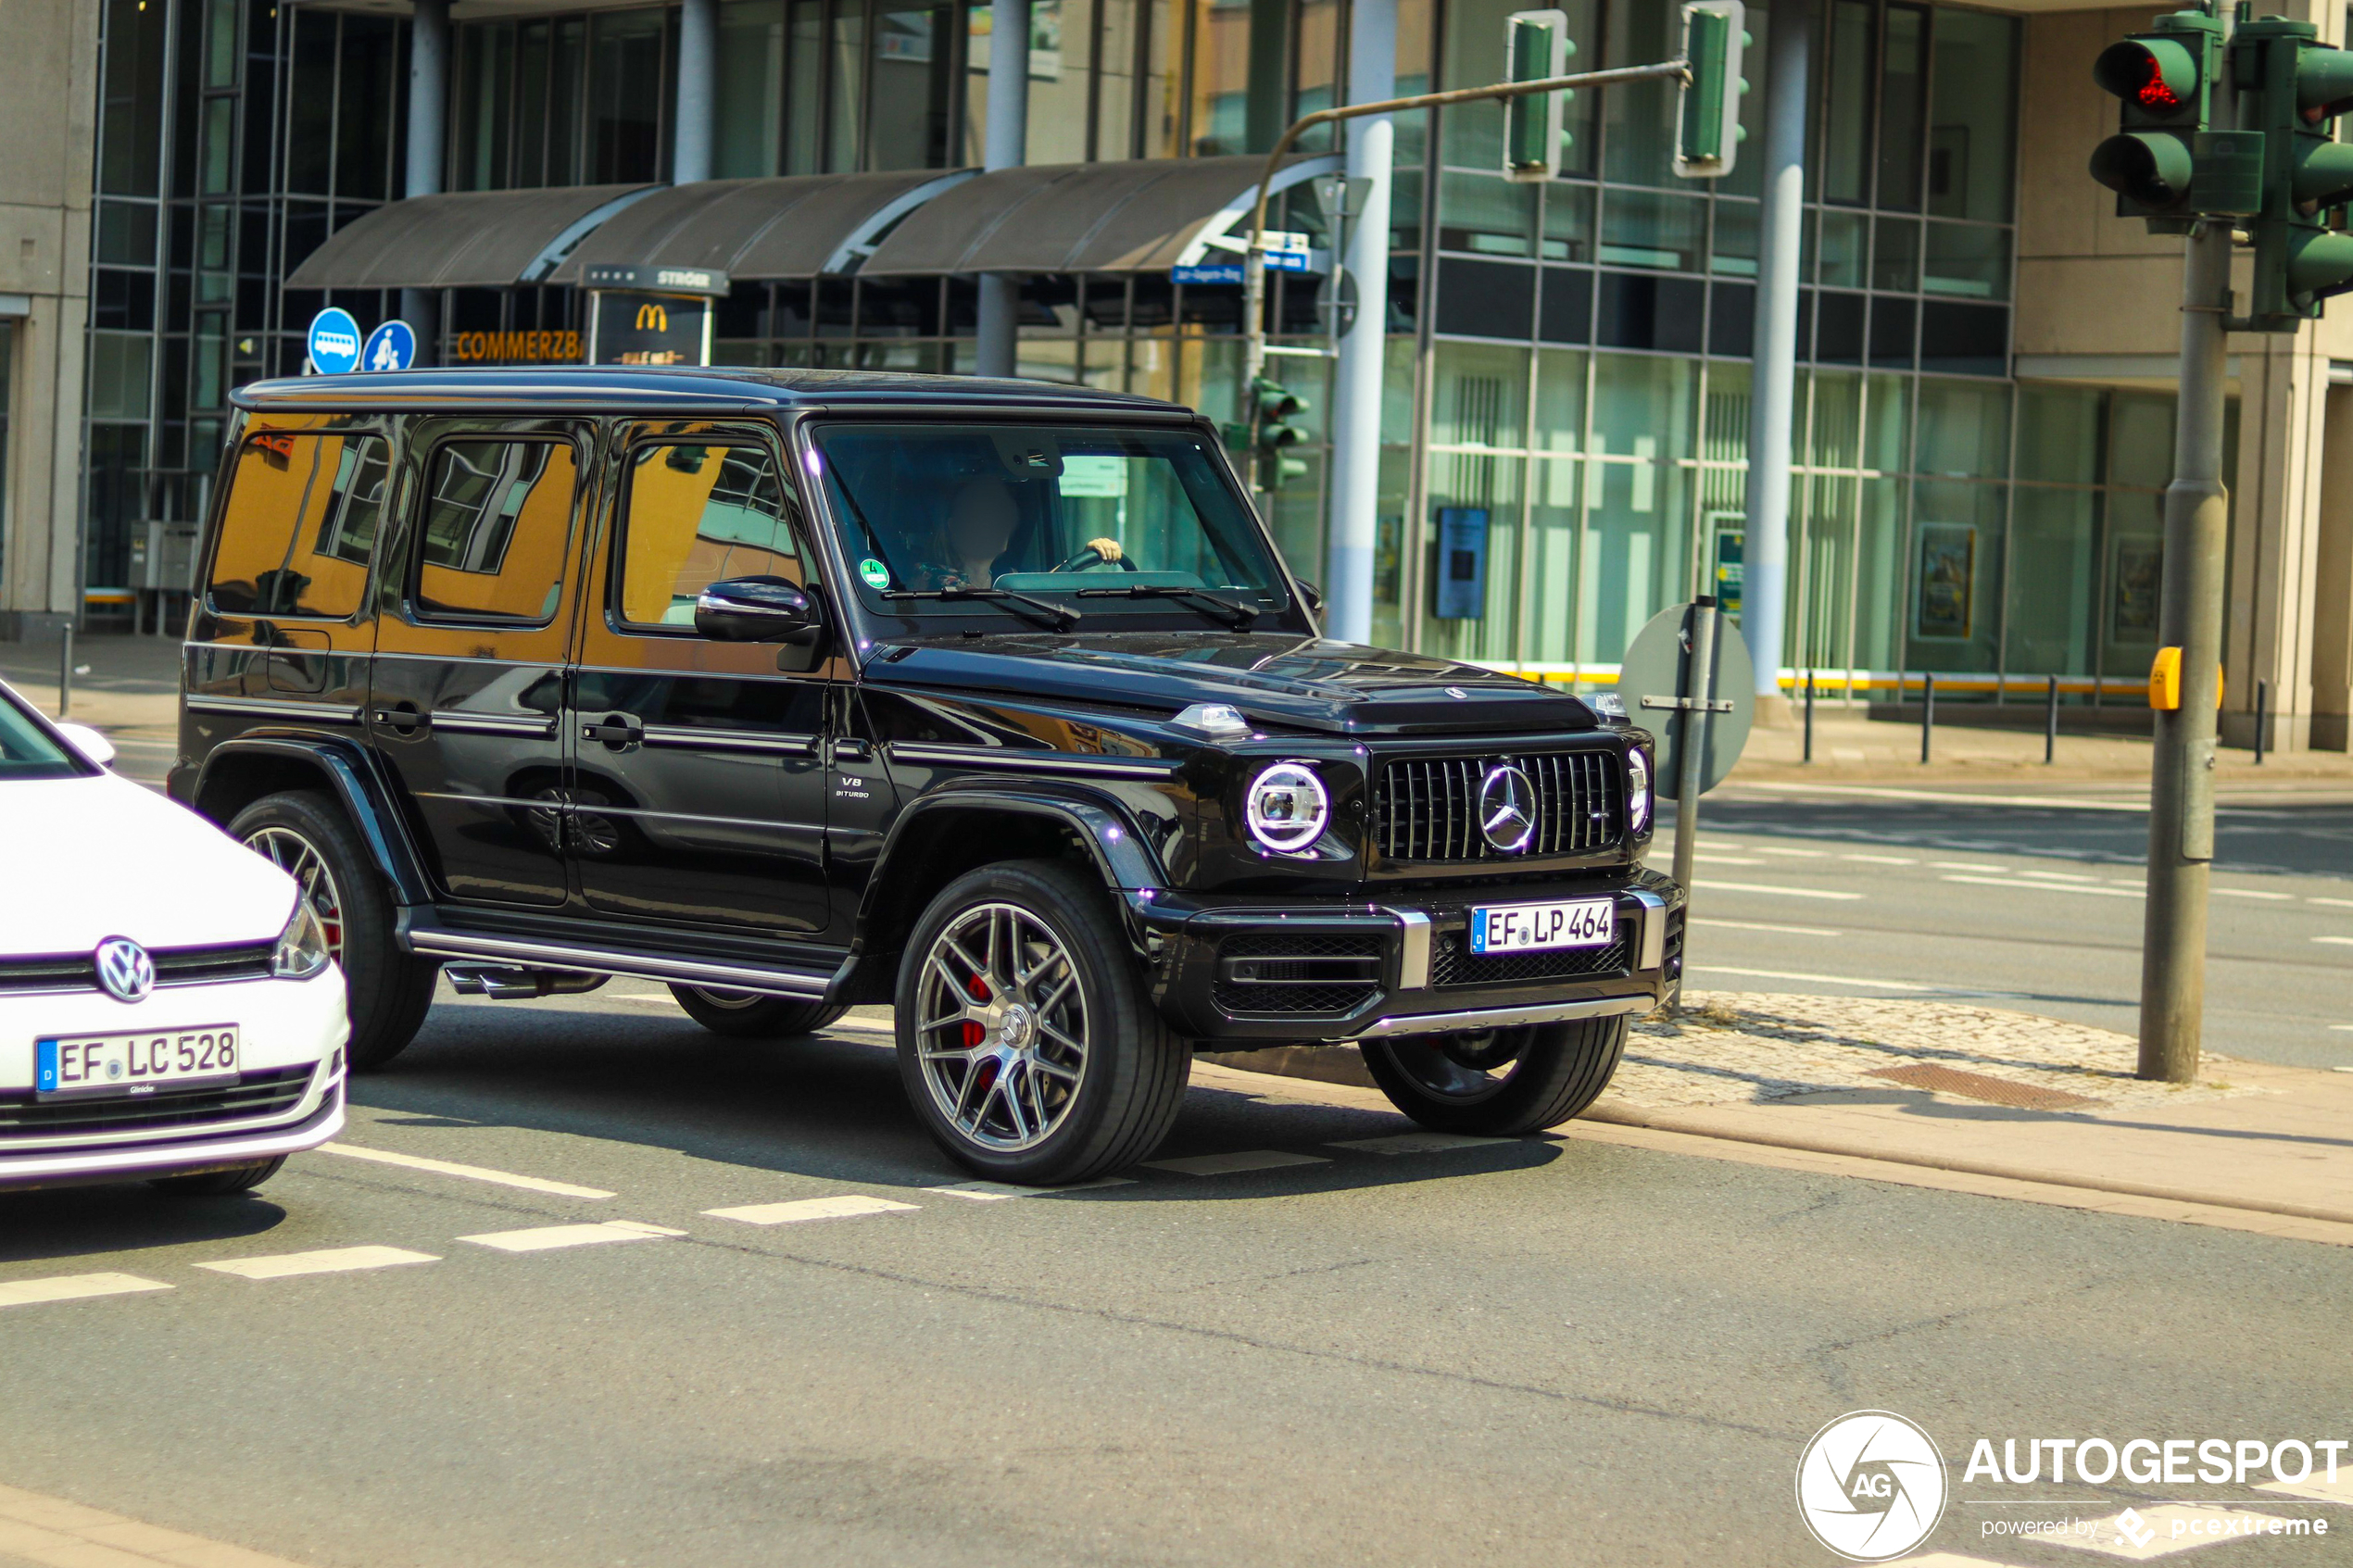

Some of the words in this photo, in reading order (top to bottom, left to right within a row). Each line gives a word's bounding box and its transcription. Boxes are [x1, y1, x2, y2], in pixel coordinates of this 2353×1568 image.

[842, 777, 862, 786] V8
[836, 790, 870, 798] BITURBO
[1488, 912, 1519, 946] EF
[1534, 909, 1564, 942] LP
[1568, 906, 1609, 940] 464
[44, 1070, 52, 1081] D
[60, 1042, 104, 1083] EF
[128, 1037, 169, 1077] LC
[178, 1032, 235, 1073] 528
